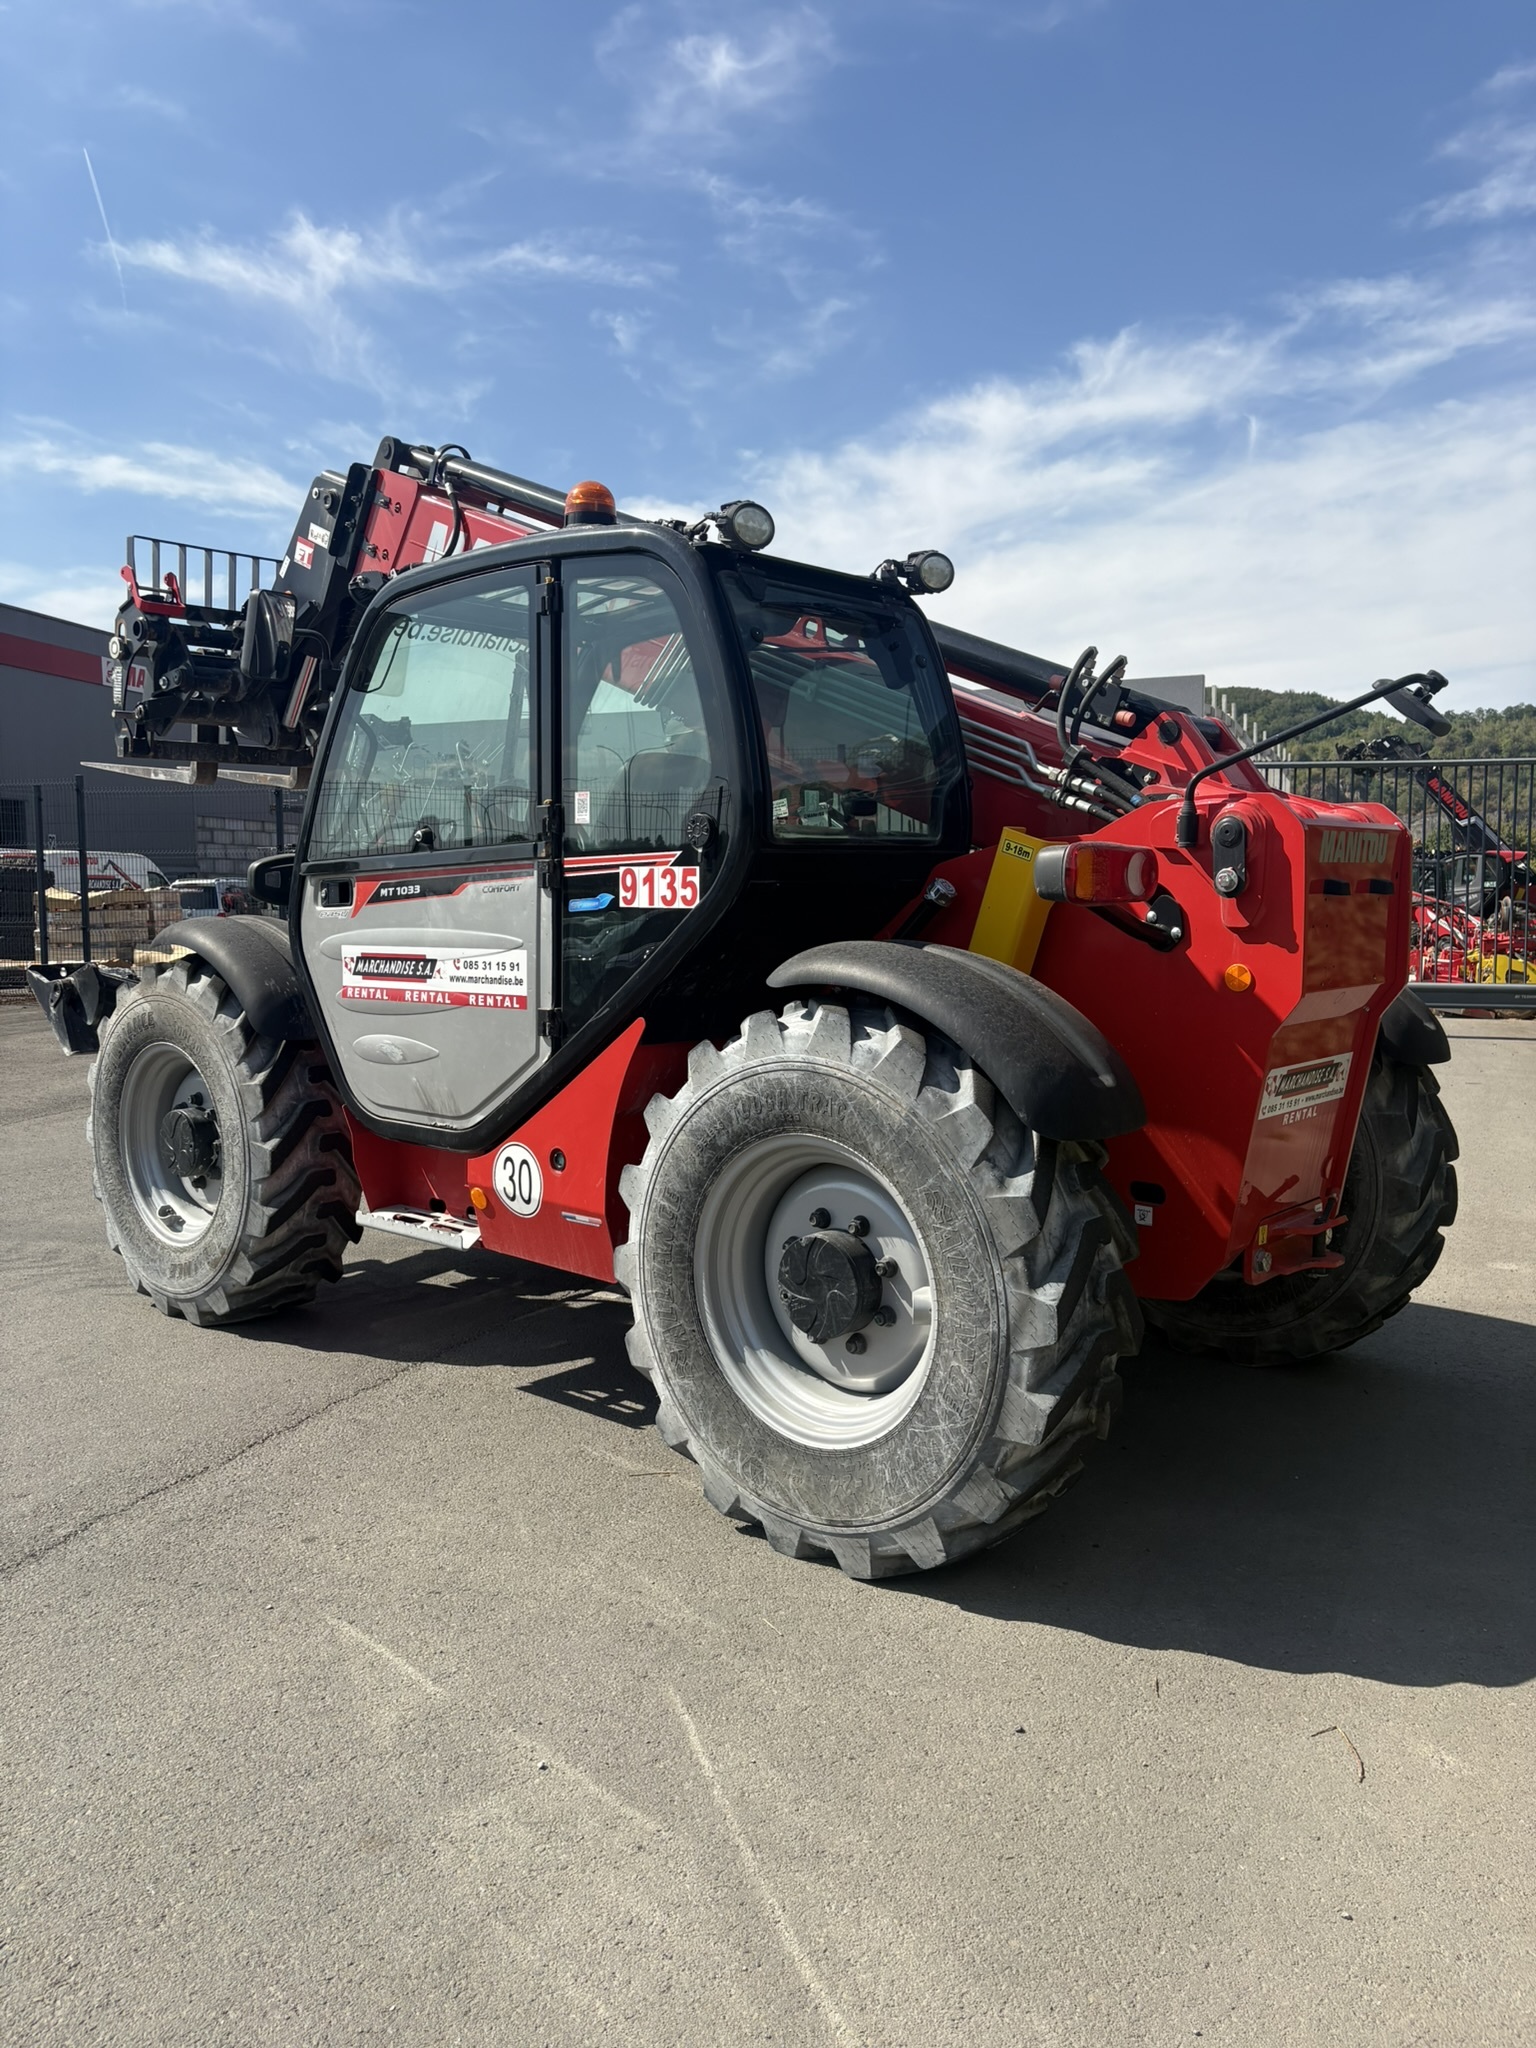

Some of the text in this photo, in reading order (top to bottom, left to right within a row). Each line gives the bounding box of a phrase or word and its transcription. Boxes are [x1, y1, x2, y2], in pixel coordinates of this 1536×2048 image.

[1005, 842, 1031, 859] 9-18m
[1319, 830, 1389, 864] MANITOU
[379, 884, 421, 897] MT 1033
[482, 883, 522, 894] COMFORT
[620, 867, 698, 907] 9135
[356, 959, 433, 976] MARCHANDISE S.A.
[463, 960, 520, 972] 085 31 15 91
[449, 974, 524, 987] www.marchandise.be
[347, 987, 520, 1008] RENTAL RENTAL RENTAL
[797, 1089, 848, 1121] TRAC
[1278, 1102, 1285, 1111] 31
[1282, 1105, 1317, 1125] RENTAL
[503, 1156, 532, 1205] 30
